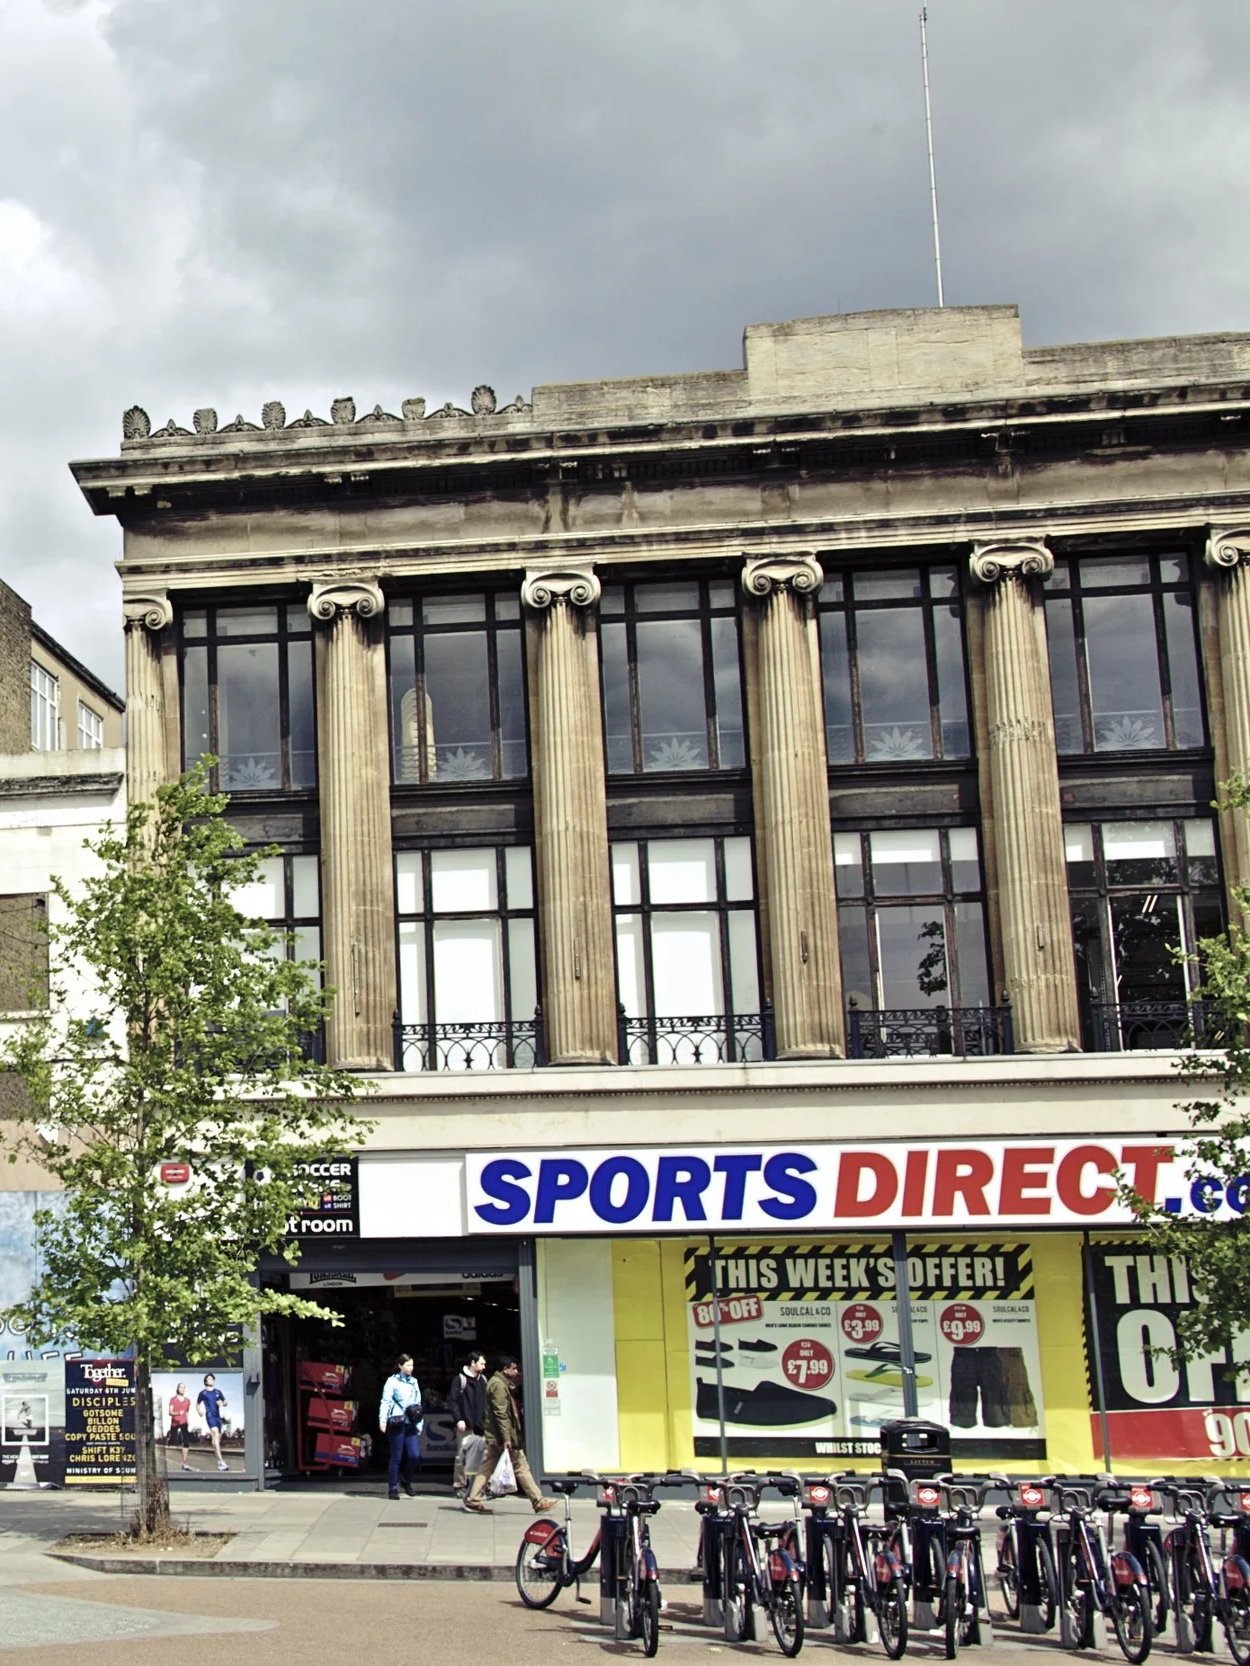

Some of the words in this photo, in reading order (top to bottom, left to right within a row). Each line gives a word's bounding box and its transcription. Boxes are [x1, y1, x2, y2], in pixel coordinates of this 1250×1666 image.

[292, 1163, 352, 1176] SOCCER
[474, 1153, 818, 1227] SPORTS
[302, 1219, 354, 1233] room
[709, 1258, 779, 1289] THIS
[785, 1257, 896, 1289] WEEK'S
[906, 1256, 1006, 1288] OFFER!
[728, 1297, 759, 1321] OFF
[844, 1319, 880, 1340] £3.99
[942, 1320, 982, 1341] £9.99
[787, 1359, 829, 1384] £7.99
[121, 1387, 136, 1395] JUN
[83, 1409, 124, 1417] GOTSOME
[87, 1417, 120, 1425] BILLON
[86, 1425, 121, 1433] GEDDES
[65, 1433, 87, 1441] COPY
[89, 1433, 116, 1441] PASTE
[119, 1432, 136, 1441] SOU
[82, 1446, 107, 1455] SHIFT
[815, 1442, 853, 1454] WHILST
[854, 1442, 882, 1454] STOC
[69, 1454, 96, 1462] CHRIS
